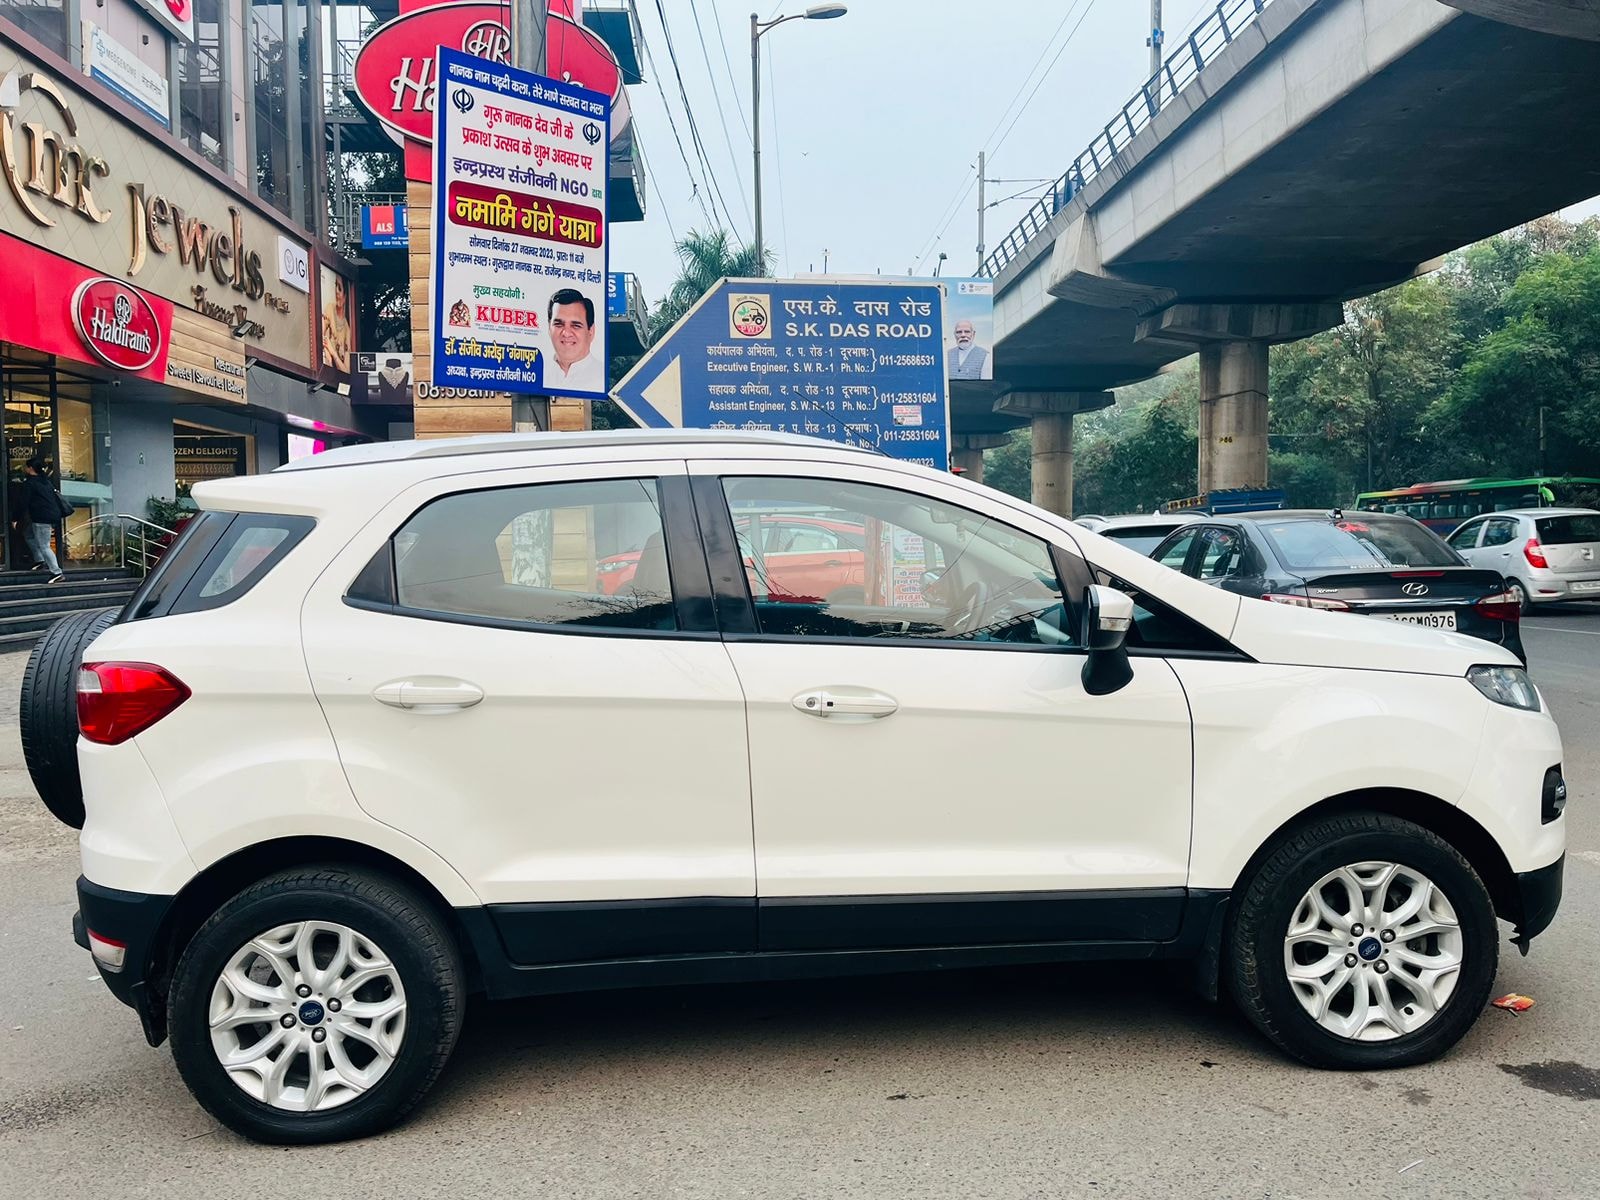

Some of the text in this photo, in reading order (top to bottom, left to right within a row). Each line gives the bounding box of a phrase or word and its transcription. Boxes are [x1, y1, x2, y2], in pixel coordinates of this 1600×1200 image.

[449, 62, 473, 80] नानक
[474, 69, 490, 85] नाम
[532, 83, 543, 99] तेरे
[589, 102, 604, 116] भला
[505, 110, 533, 130] नानक
[535, 113, 548, 134] देव
[550, 117, 562, 138] जी
[564, 121, 574, 140] के
[462, 127, 593, 171] प्रकाश उत्सव के शुभ अवसर पर
[452, 157, 505, 180] इन्द्रप्रस्थ
[508, 165, 558, 191] संजीवनी
[560, 178, 589, 197] NGO
[455, 193, 597, 243] नमामि गंगे यात्रा
[376, 223, 393, 232] ALS
[469, 234, 491, 250] सोमवार
[492, 236, 511, 252] दिनांक
[511, 242, 519, 253] 27
[539, 247, 555, 260] 2023,
[515, 261, 532, 273] नानक
[587, 269, 601, 284] दिल्ली
[473, 285, 491, 299] मुख्य
[492, 286, 521, 300] सहयोगी
[853, 301, 890, 316] दास
[899, 296, 931, 316] रोड
[476, 305, 539, 328] KUBER
[90, 306, 151, 354] Haldiram's
[785, 323, 932, 338] S.K. DAS ROAD
[444, 336, 457, 356] डॉ.
[458, 337, 482, 357] संजीव
[483, 340, 505, 363] अरोड़ा
[706, 343, 743, 357] कार्यपालक
[785, 346, 794, 358] द.
[810, 344, 823, 357] रोड
[707, 362, 748, 372] Executive
[751, 362, 789, 374] Engineer,
[840, 363, 853, 373] Ph.
[879, 355, 935, 366] 011-25686531
[168, 361, 193, 381] Sweets
[496, 366, 521, 382] संजीवनी
[521, 371, 536, 382] NGO
[708, 384, 737, 396] सहायक
[780, 385, 789, 396] द.
[805, 383, 819, 395] रोड
[881, 393, 937, 404] 011-25831604
[709, 401, 748, 411] Assistant
[749, 401, 786, 413] Engineer,
[842, 402, 854, 411] Ph.
[805, 421, 819, 434] रोड
[884, 431, 940, 441] 011-25831604
[196, 447, 238, 455] DELIGHTS
